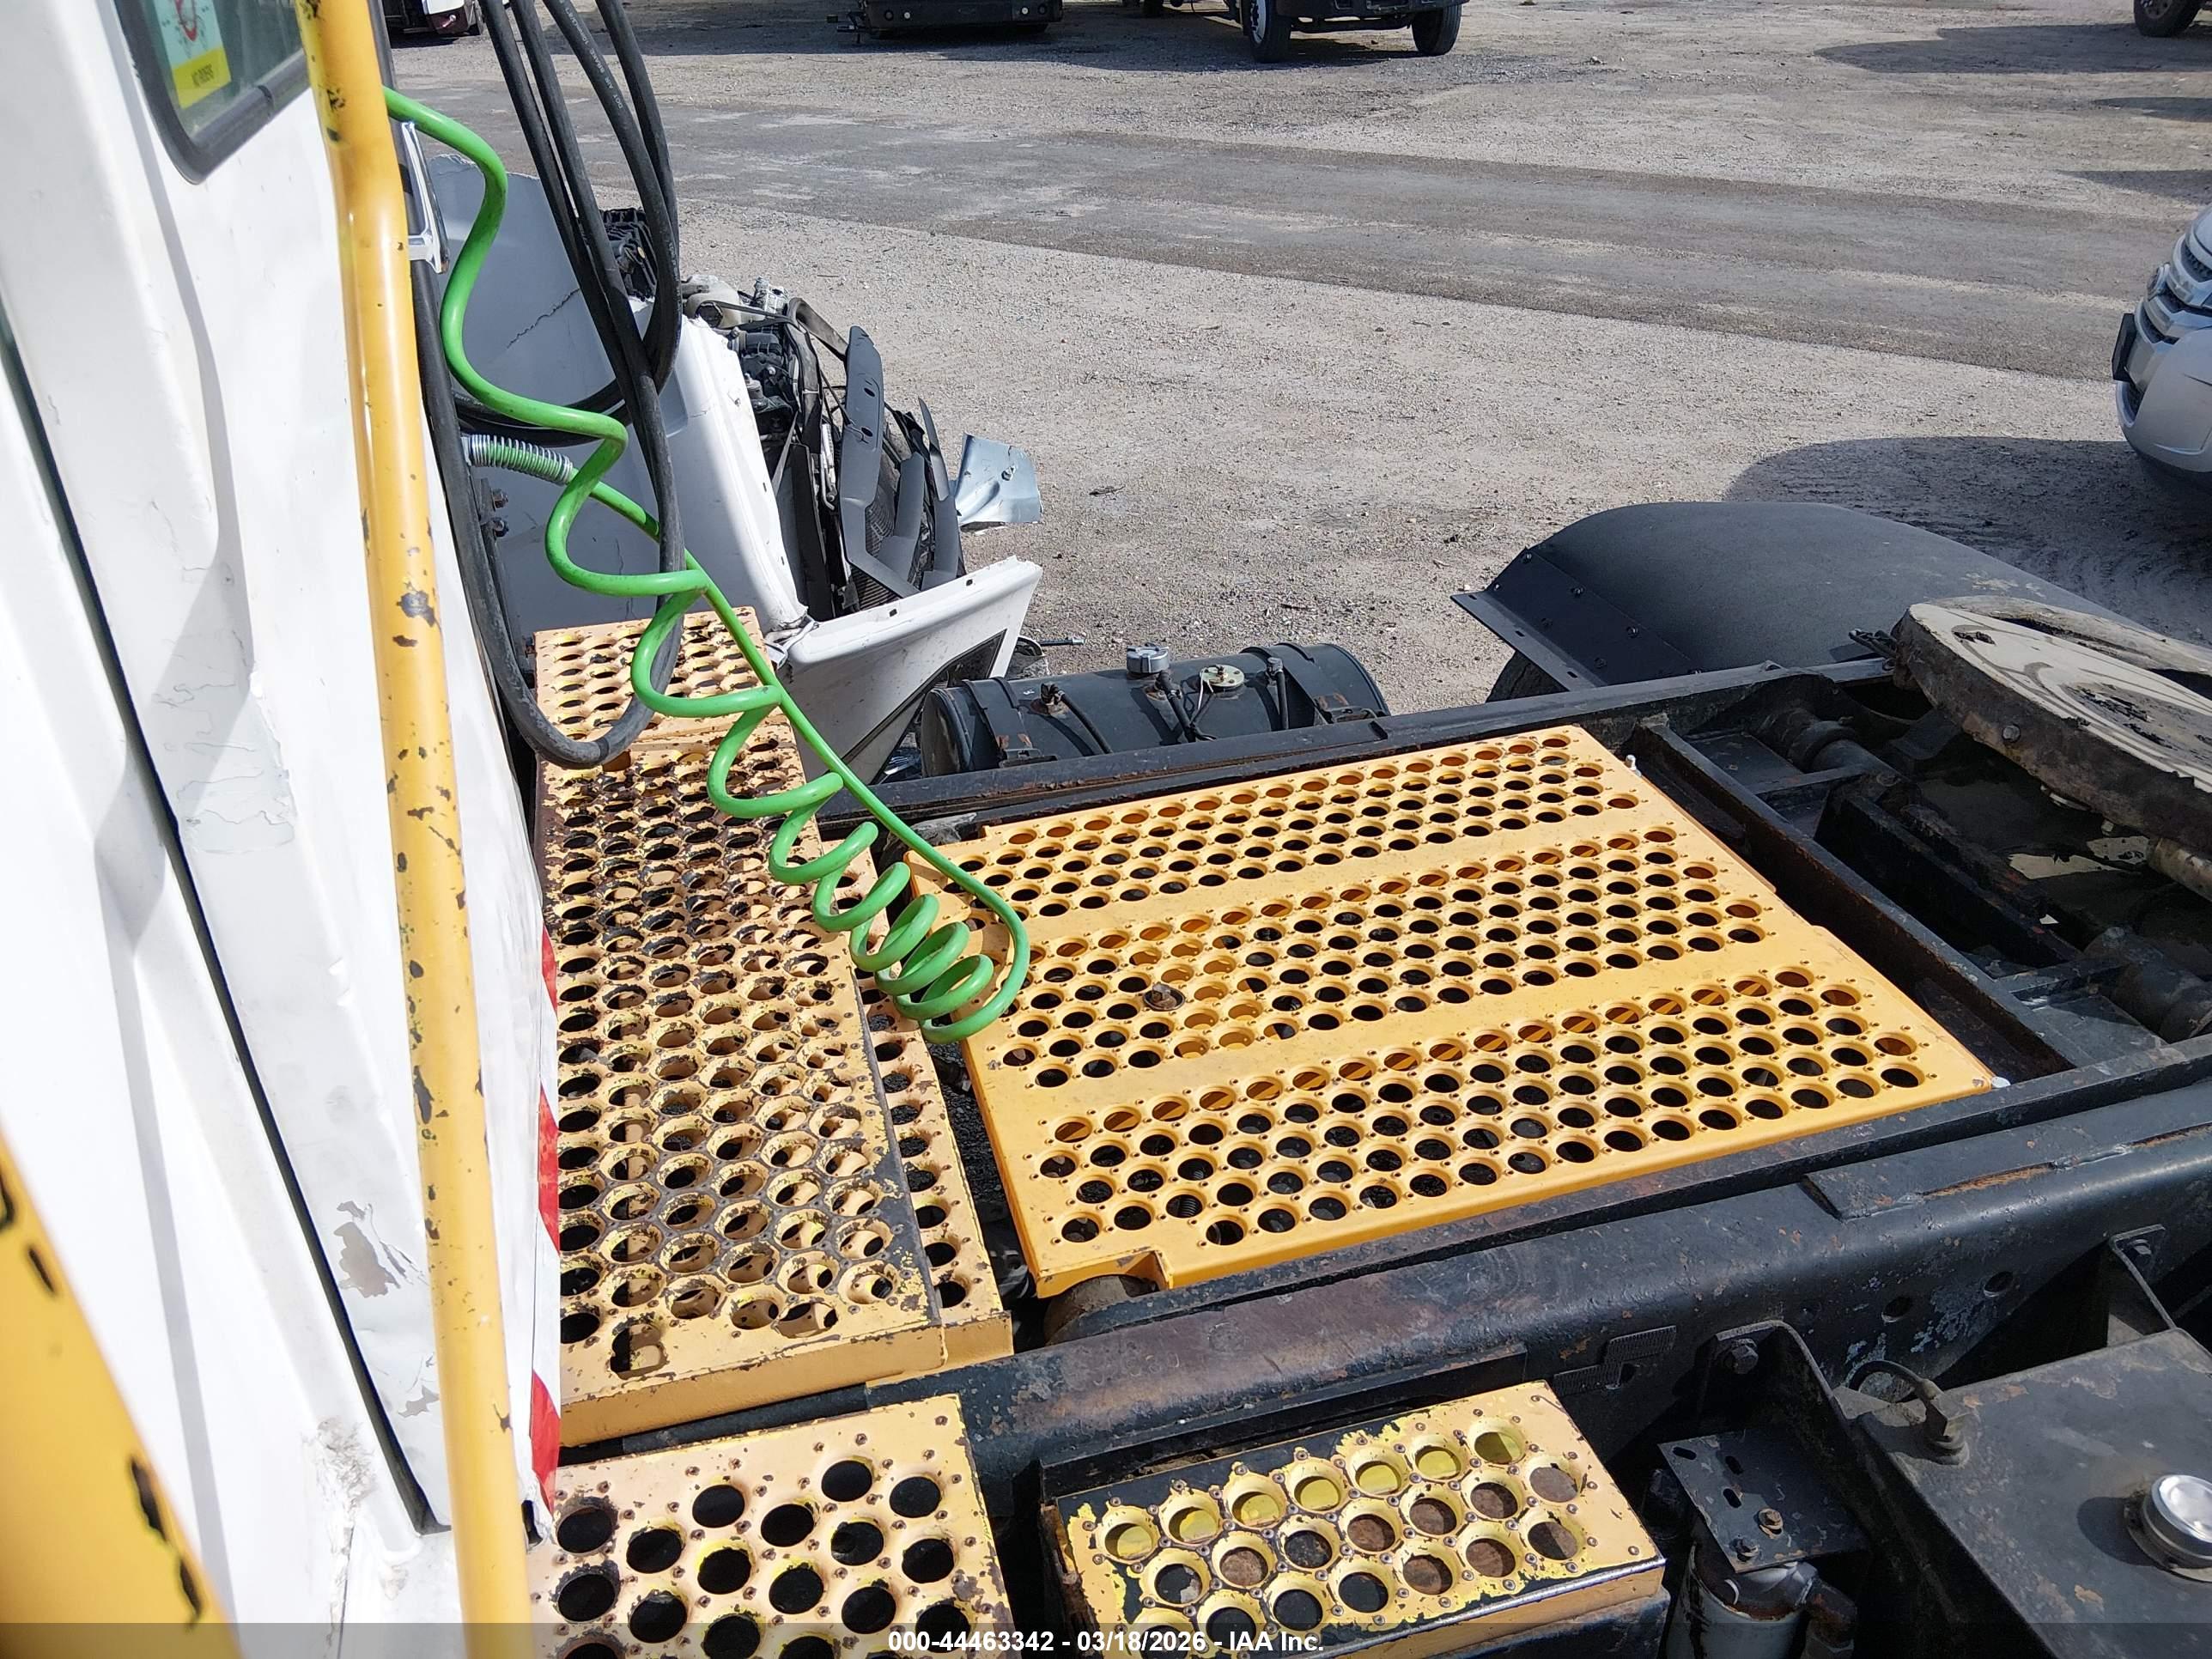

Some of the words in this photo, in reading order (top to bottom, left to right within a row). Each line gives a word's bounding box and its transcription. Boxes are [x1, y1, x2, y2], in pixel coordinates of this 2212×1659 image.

[589, 48, 605, 74] BRAKE
[605, 77, 614, 89] AIR
[612, 94, 624, 109] DOT
